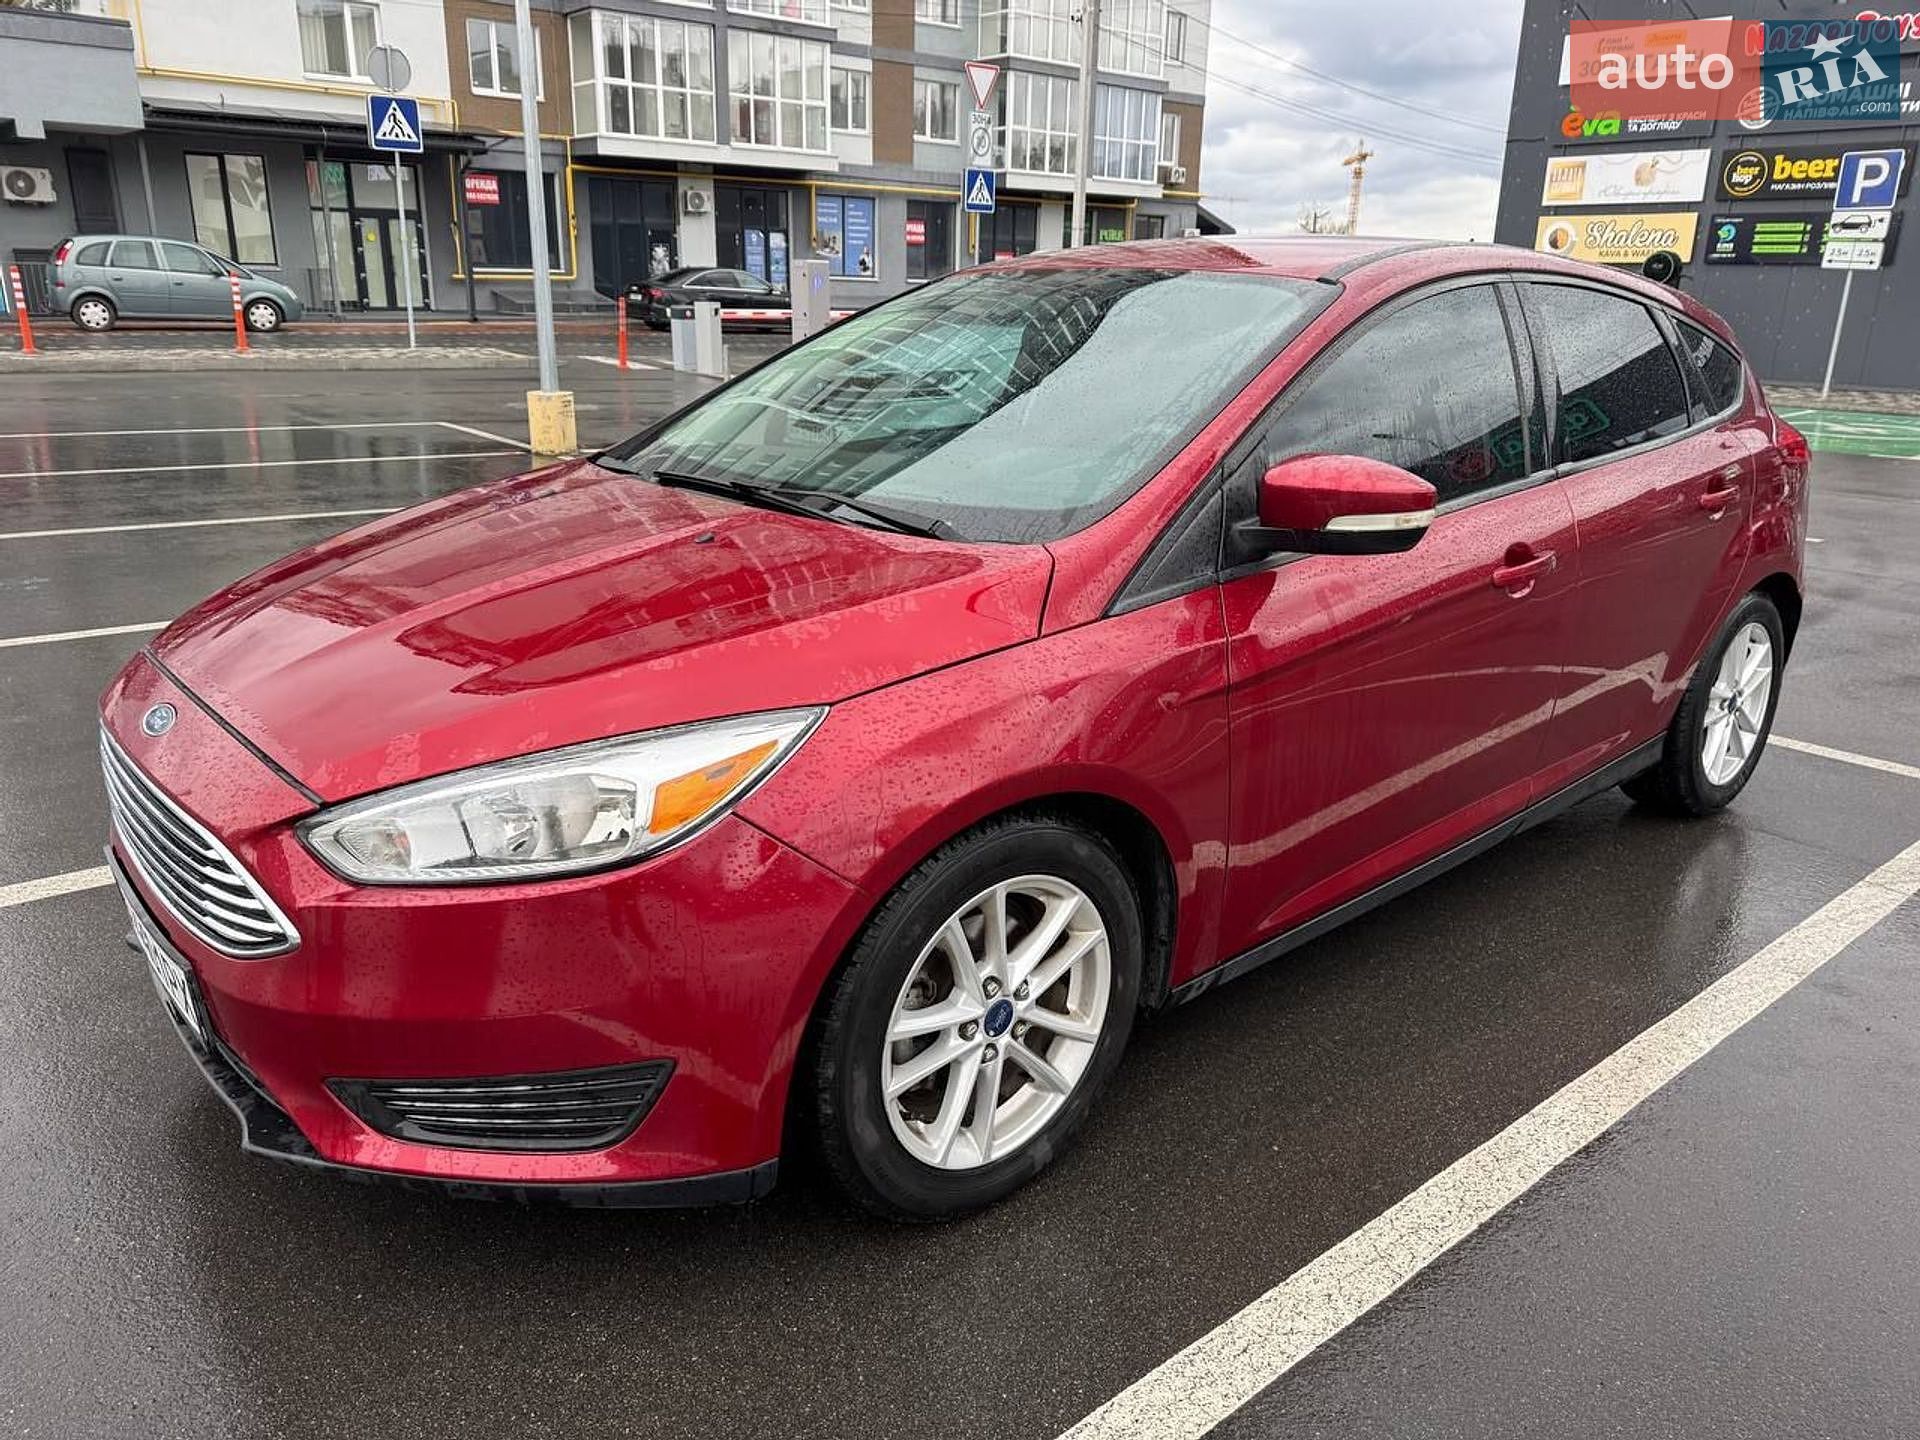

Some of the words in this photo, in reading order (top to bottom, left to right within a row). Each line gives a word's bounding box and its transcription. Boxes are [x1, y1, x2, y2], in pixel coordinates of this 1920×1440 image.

[971, 112, 991, 125] ЗОНА
[1773, 154, 1840, 181] beer
[1852, 157, 1890, 204] P
[1584, 220, 1679, 249] Shalena
